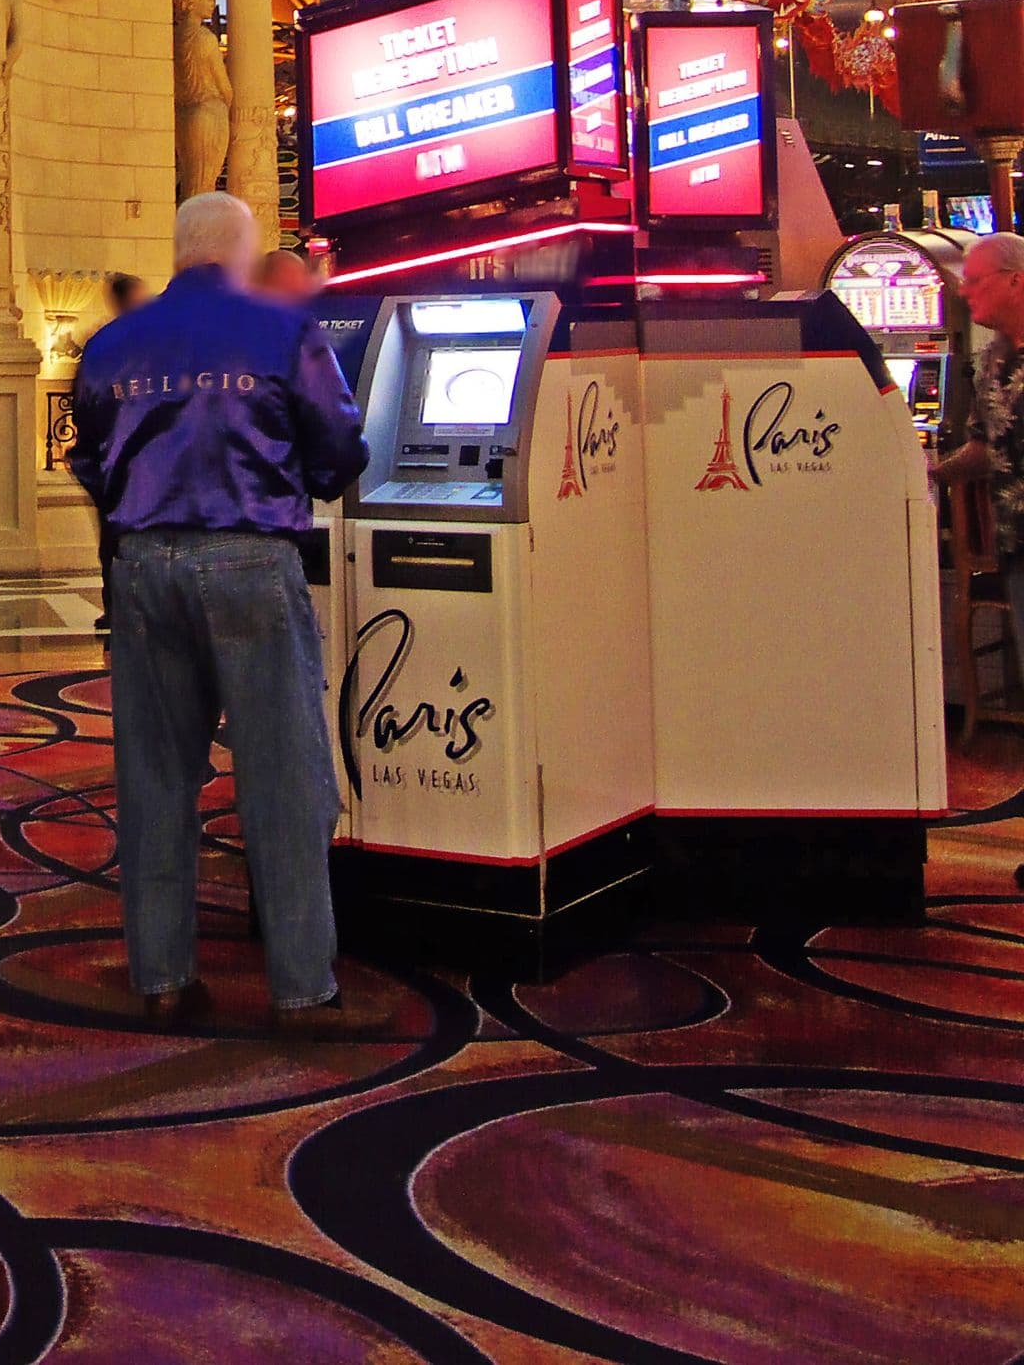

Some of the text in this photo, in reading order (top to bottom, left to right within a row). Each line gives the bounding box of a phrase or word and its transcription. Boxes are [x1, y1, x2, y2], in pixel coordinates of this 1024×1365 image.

[379, 17, 457, 61] TICKET
[354, 85, 516, 148] BILL BREAKER
[330, 319, 365, 330] TICKET
[112, 372, 255, 399] BELLGIO
[577, 380, 619, 491] Paris
[743, 382, 840, 486] Paris
[770, 462, 833, 473] LAS VEGAS
[339, 609, 492, 801] Paris
[373, 764, 477, 792] LAS VEGAS
